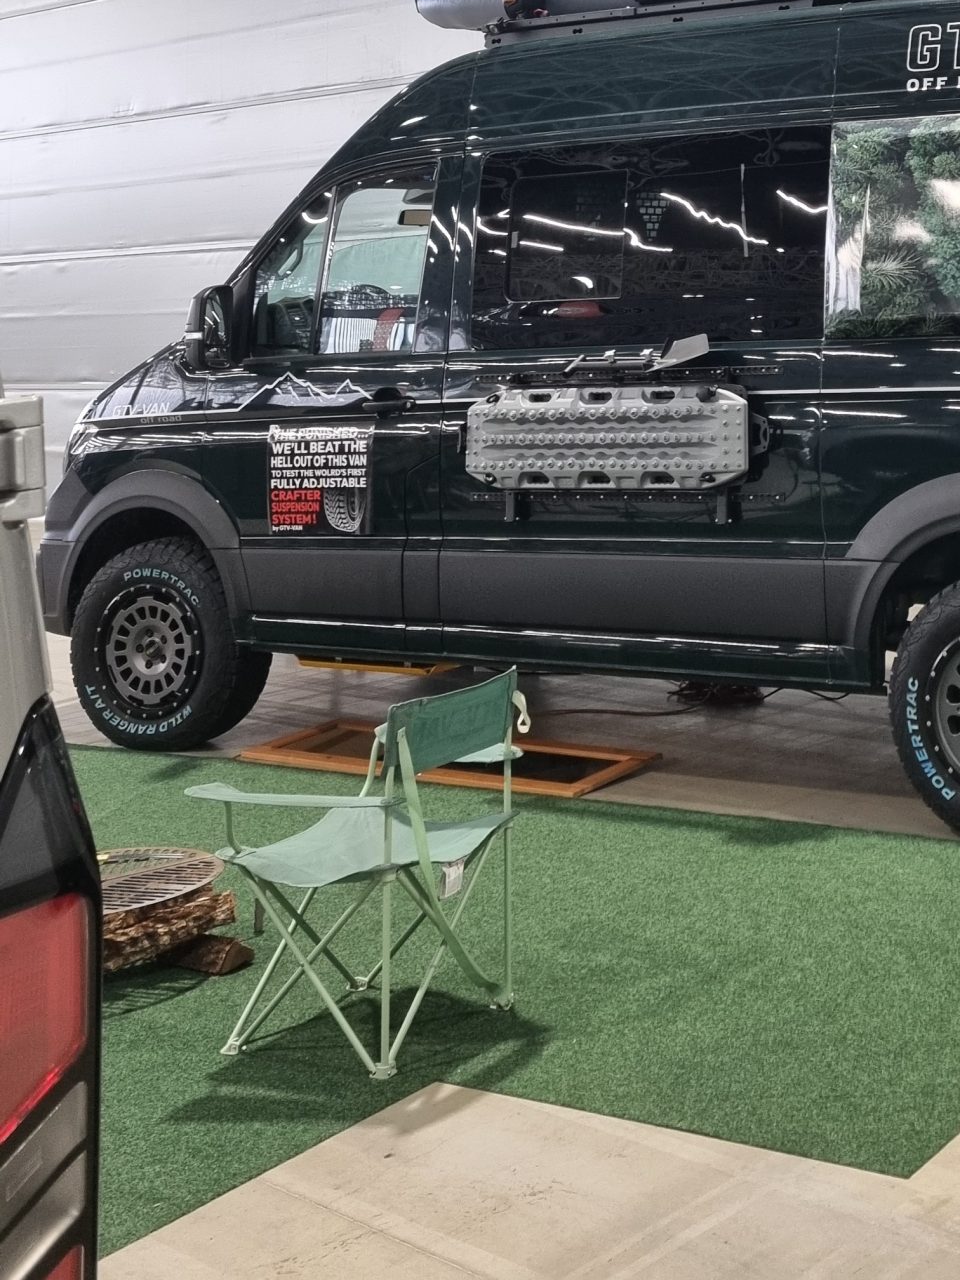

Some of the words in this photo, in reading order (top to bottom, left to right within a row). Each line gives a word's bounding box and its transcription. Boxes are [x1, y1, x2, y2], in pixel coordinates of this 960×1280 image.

[906, 76, 948, 92] OFF
[113, 402, 170, 416] GTV-VAN
[140, 416, 154, 424] off
[272, 441, 308, 454] WE'LL
[309, 441, 341, 453] BEAT
[342, 440, 367, 452] THE
[271, 456, 293, 468] HELL
[294, 456, 312, 467] OUT
[313, 455, 326, 467] OF
[327, 455, 347, 466] THIS
[348, 455, 367, 466] VAN
[299, 469, 314, 477] THE
[347, 468, 366, 476] FIRST
[271, 479, 301, 489] FULLY
[302, 477, 367, 488] ADJUSTABLE
[271, 490, 321, 500] CRAFTER
[271, 501, 320, 512] SUSPENSION
[123, 568, 200, 607] POWERTRAC
[102, 710, 159, 735] RANGER
[158, 705, 193, 732] WILD
[906, 676, 956, 801] POWERTRAC
